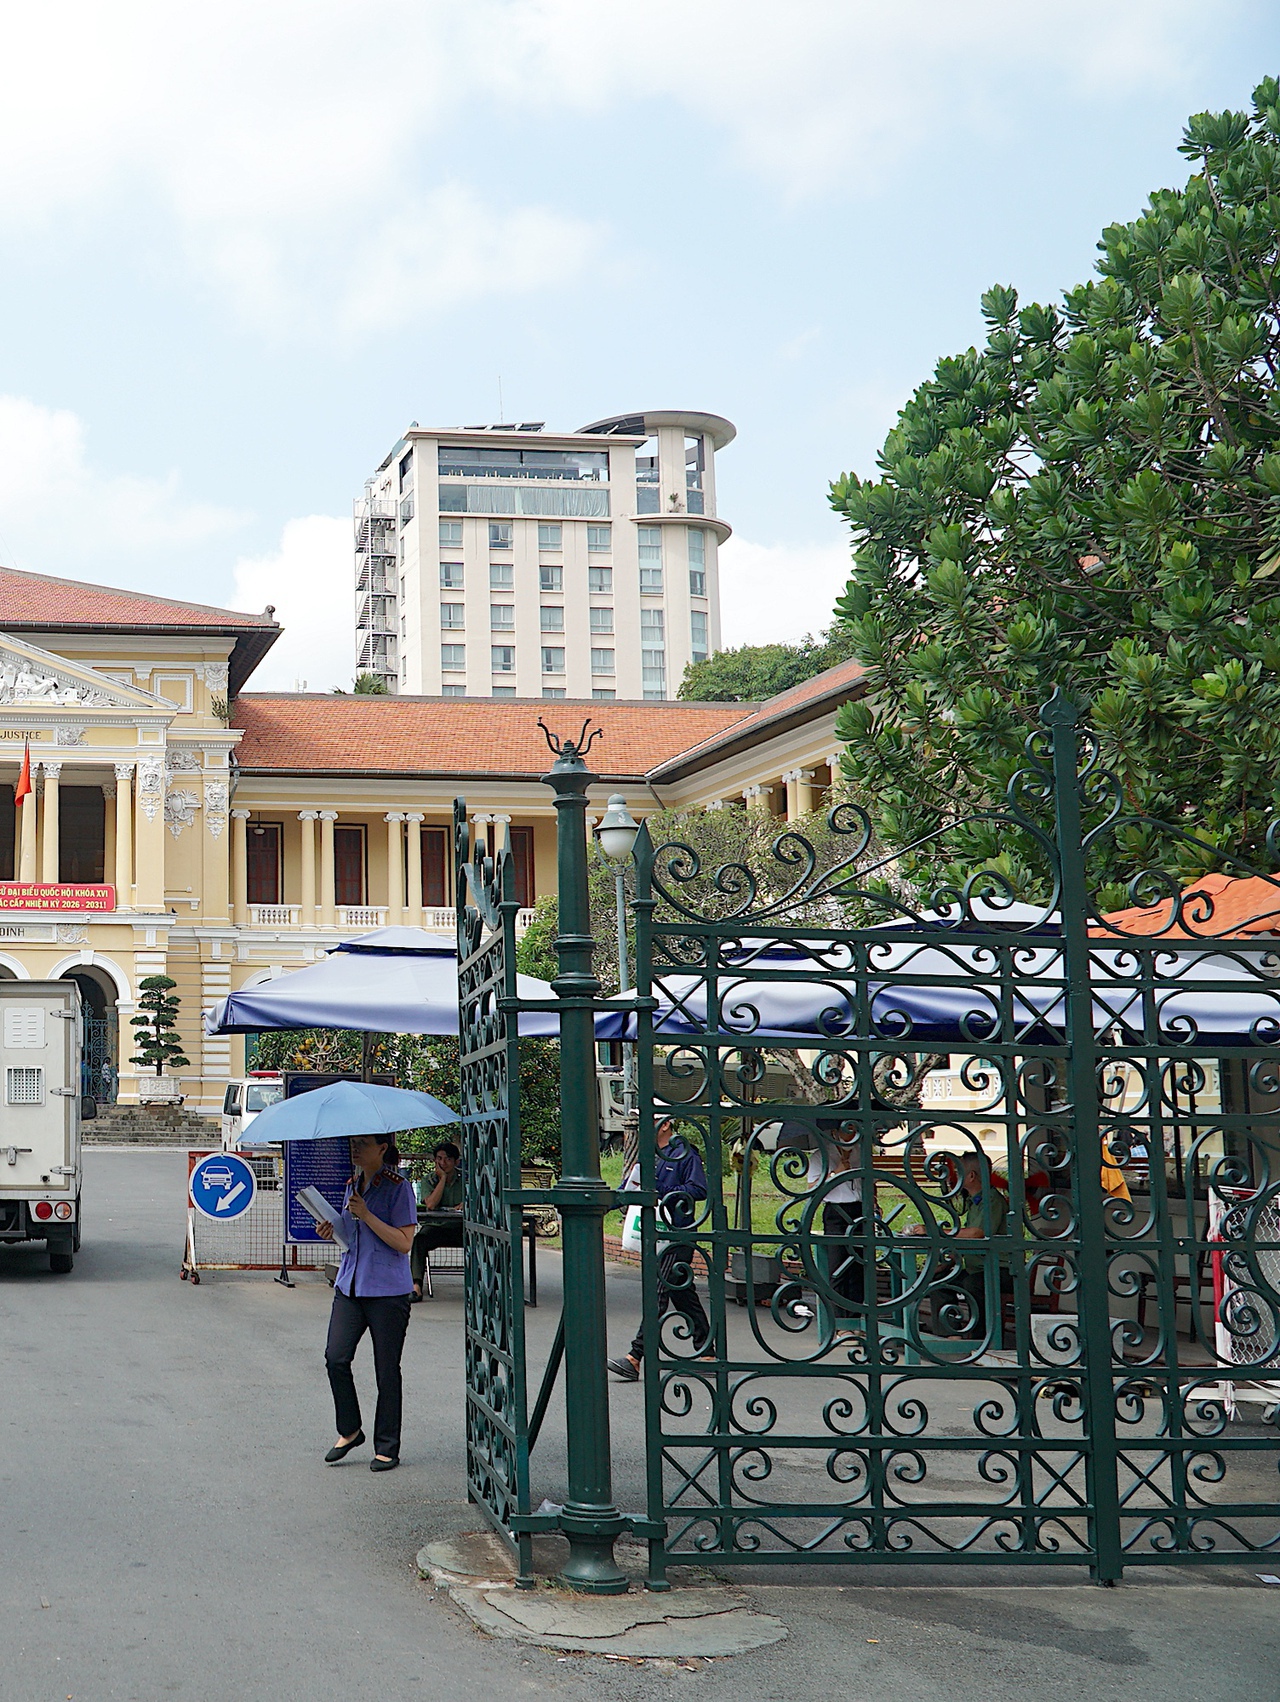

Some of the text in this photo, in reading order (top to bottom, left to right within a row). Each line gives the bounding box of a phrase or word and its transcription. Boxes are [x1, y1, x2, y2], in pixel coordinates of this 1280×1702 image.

[0, 731, 41, 740] JUSTICE
[8, 887, 20, 898] ĐẠI
[21, 885, 39, 896] BIỂU
[40, 886, 60, 898] QUỐC
[61, 887, 74, 898] HỘI
[75, 888, 95, 898] KHÓA
[96, 890, 109, 898] XVI
[9, 897, 24, 907] CẤP
[25, 898, 49, 909] NHIỆM
[61, 900, 80, 909] 2026
[85, 900, 107, 909] 2031!
